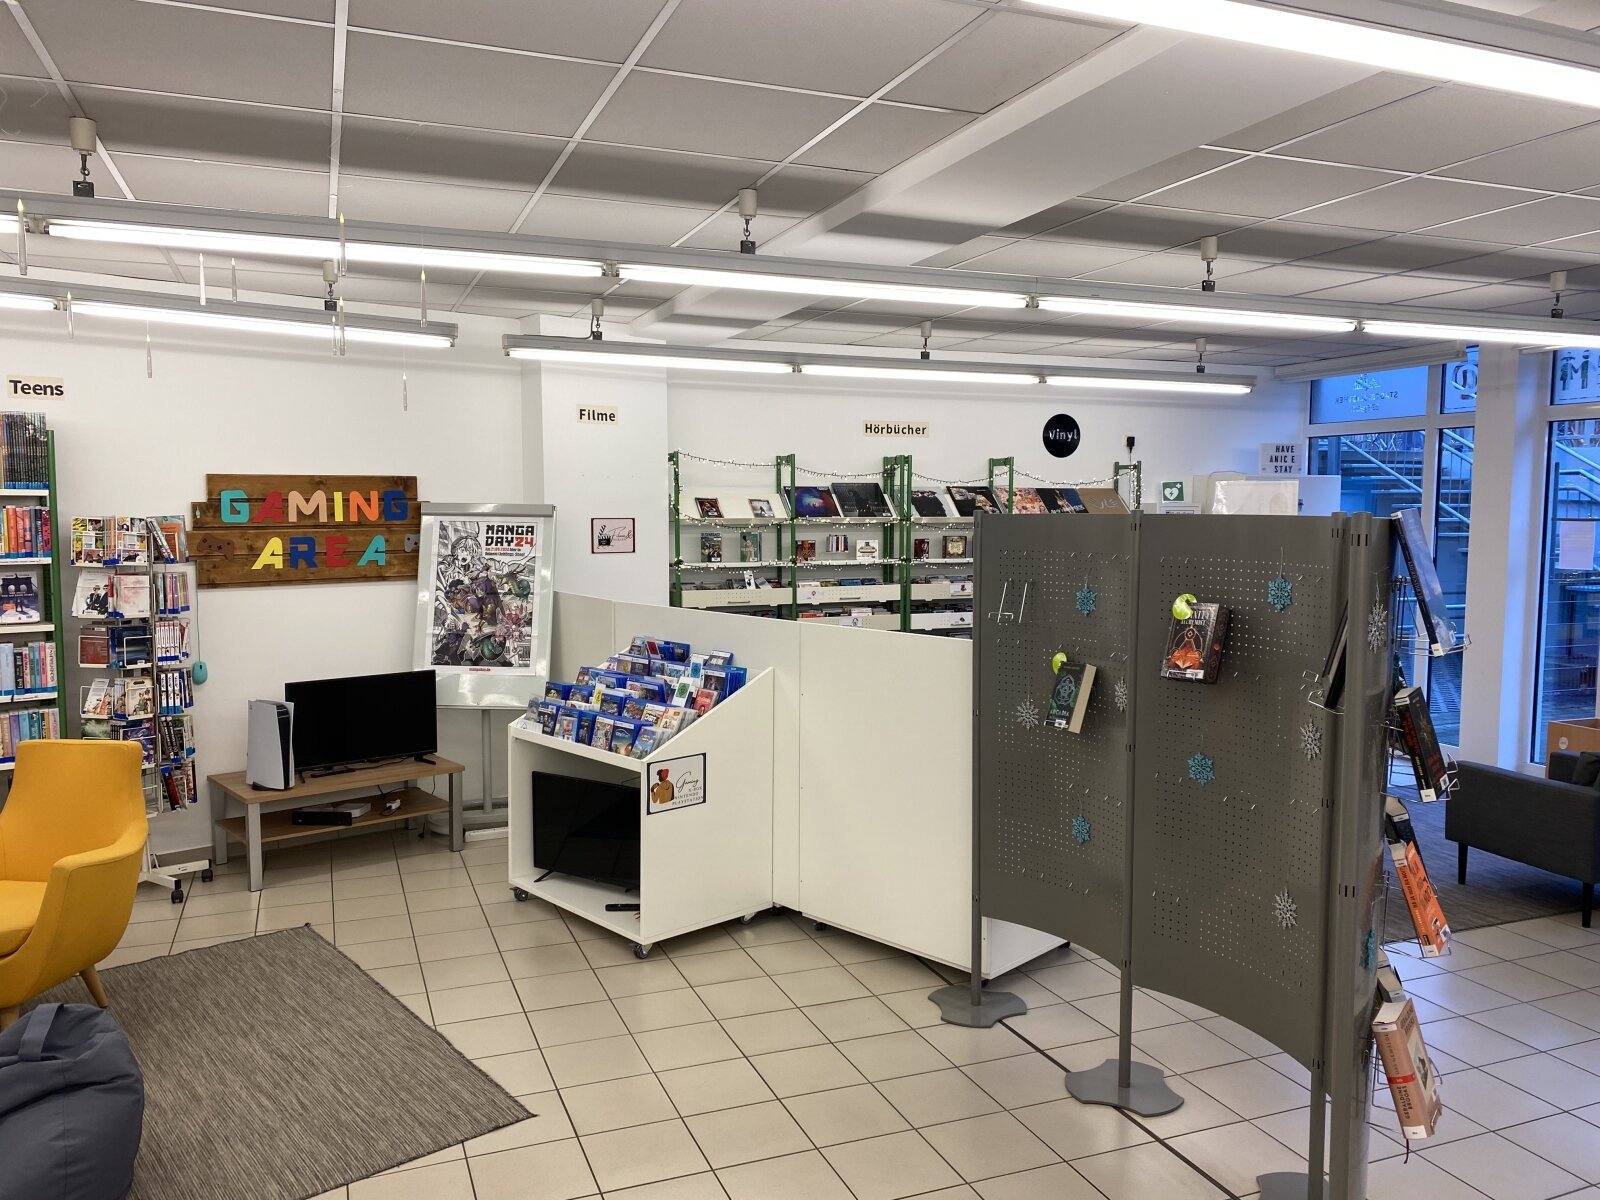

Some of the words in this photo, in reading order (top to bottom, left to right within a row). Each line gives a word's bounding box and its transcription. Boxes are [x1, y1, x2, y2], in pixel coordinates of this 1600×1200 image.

[9, 379, 64, 396] Teens
[579, 409, 616, 422] Filme
[865, 423, 927, 435] Hörbücher
[1049, 428, 1078, 442] Vinyl
[1275, 445, 1295, 453] HAVE
[1274, 465, 1293, 474] STAY
[220, 489, 409, 523] GAMING
[485, 524, 534, 536] MANGA
[251, 534, 387, 570] AREA
[1397, 1086, 1410, 1119] GERALDINE
[1402, 1085, 1413, 1110] BROOKS
